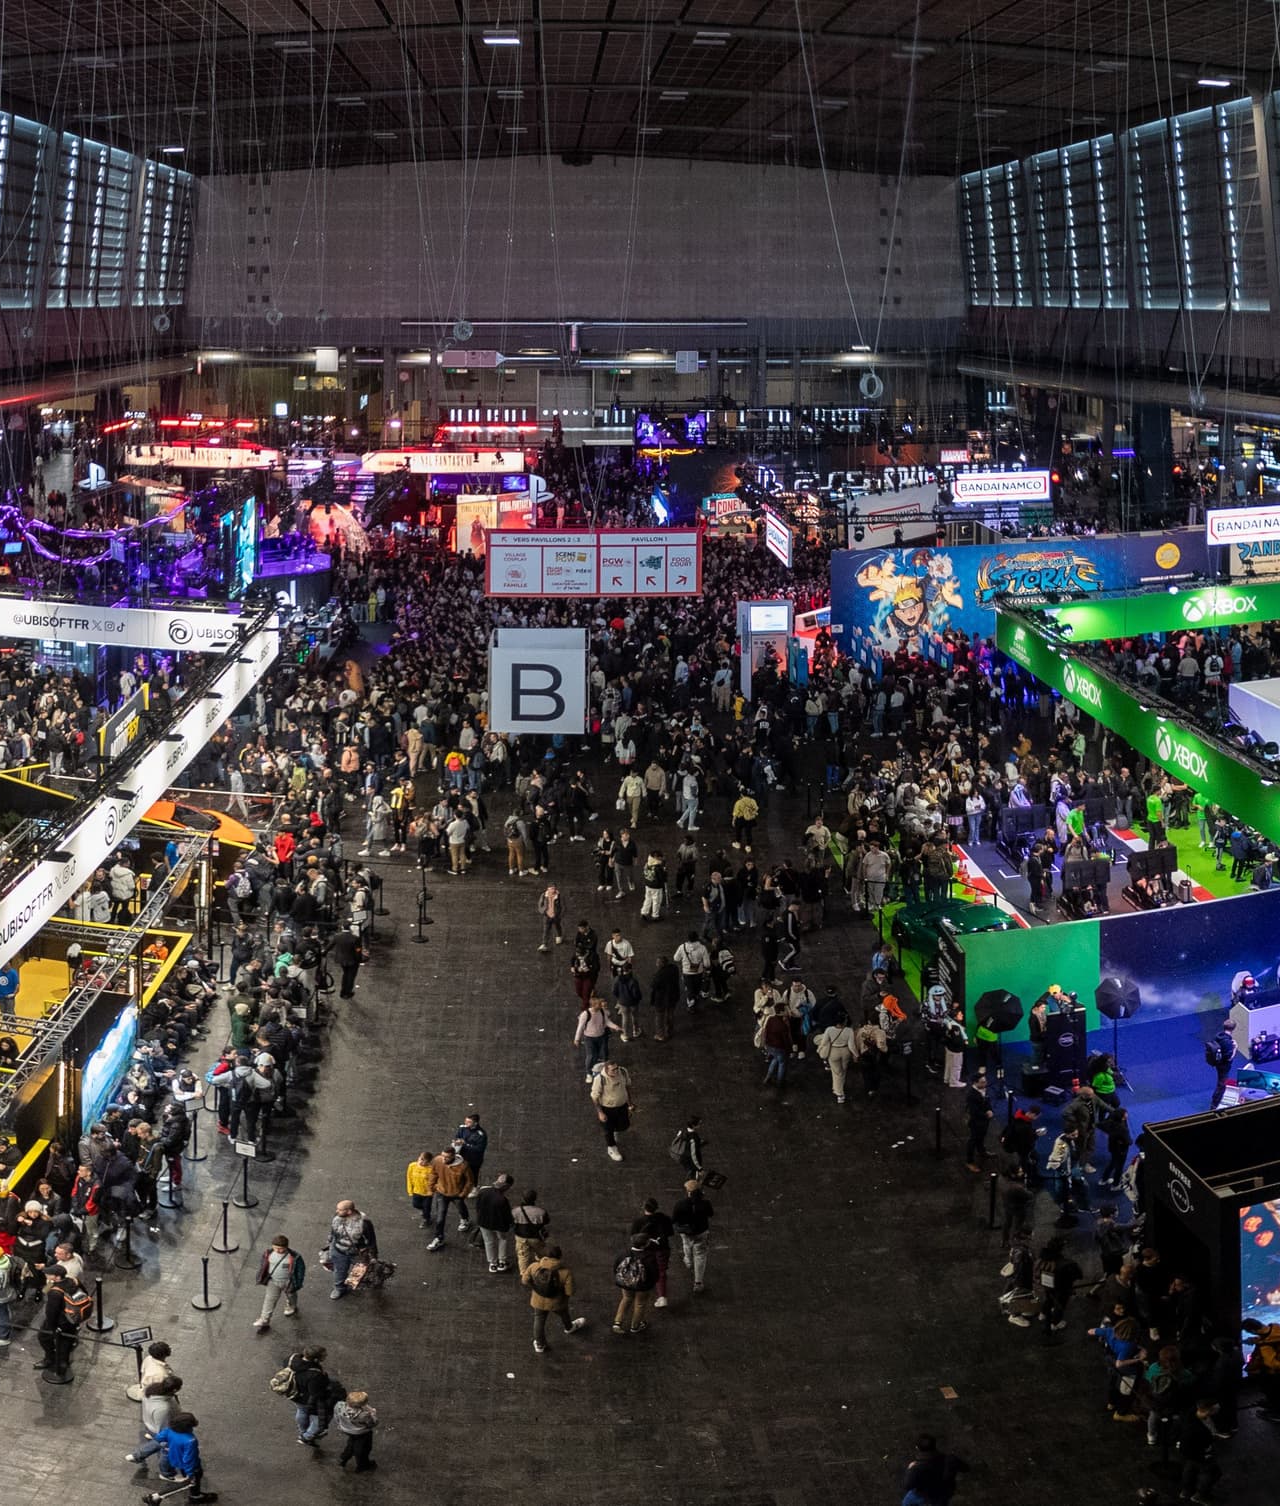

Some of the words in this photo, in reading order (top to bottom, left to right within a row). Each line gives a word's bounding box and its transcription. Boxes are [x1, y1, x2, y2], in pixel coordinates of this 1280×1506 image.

[412, 455, 433, 466] FINAL
[960, 482, 1000, 494] BANDAI
[1001, 479, 1043, 493] NAMCO
[1217, 519, 1261, 532] BANDAI
[1209, 596, 1258, 617] XBOX
[13, 614, 90, 631] @UBISOFTFR
[196, 625, 241, 641] UBISOF
[511, 663, 566, 722] B
[1077, 674, 1103, 709] XBOX
[1173, 740, 1208, 783] XBOX
